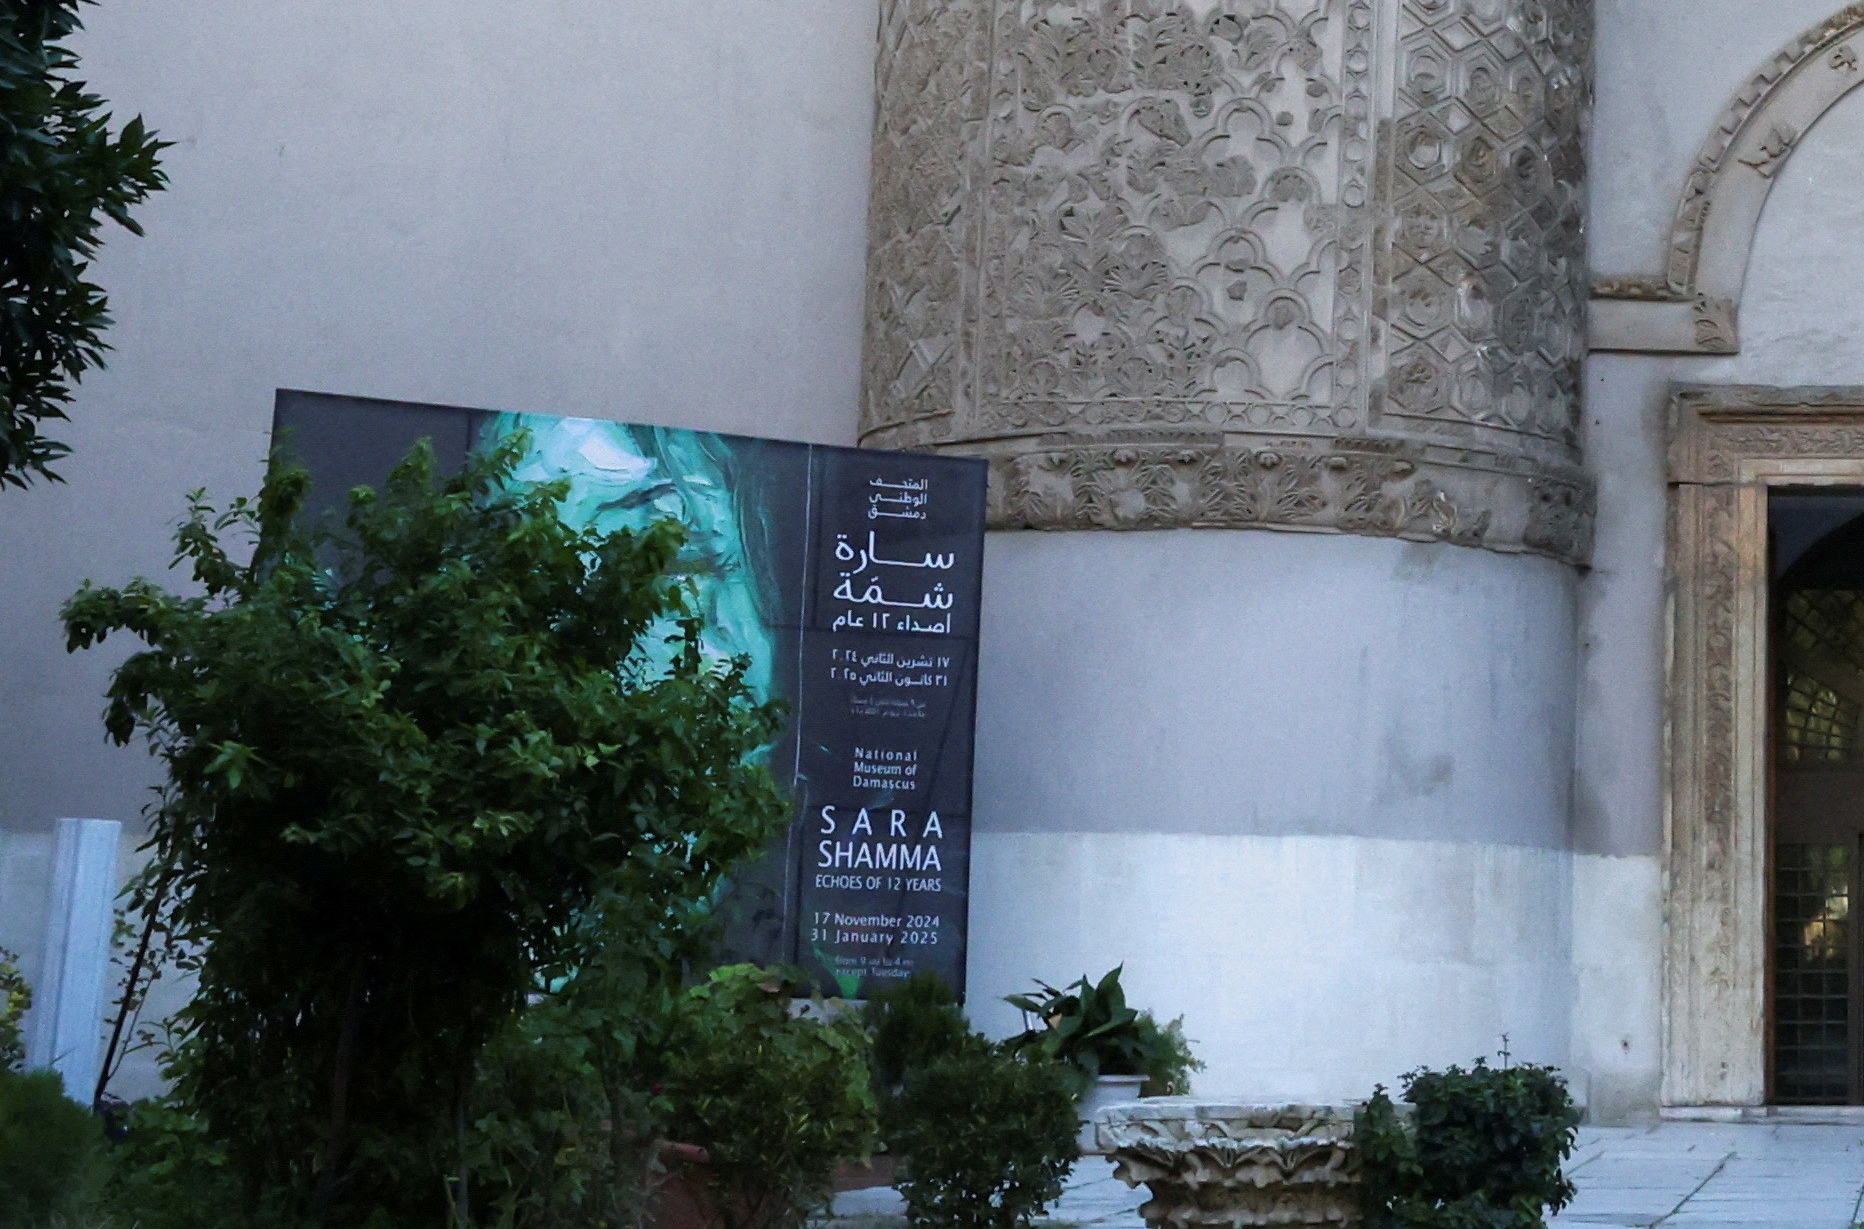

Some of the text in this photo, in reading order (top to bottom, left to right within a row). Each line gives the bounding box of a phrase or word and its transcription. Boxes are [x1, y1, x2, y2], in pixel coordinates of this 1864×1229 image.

[869, 477, 928, 490] المتحف
[868, 492, 928, 507] الوطني
[867, 504, 927, 519] دمشق
[835, 530, 955, 574] سارة
[832, 610, 864, 632] عام
[872, 612, 890, 629] ١٢
[896, 654, 933, 669] تشرين
[937, 656, 950, 668] ١٧
[935, 674, 948, 686] ٣١
[854, 746, 917, 761] National
[853, 761, 917, 776] Museum of
[852, 775, 916, 790] Damascus
[817, 839, 942, 872] SHAMMA
[815, 874, 942, 892] ECHOES OF 12 YEARS
[814, 912, 940, 928] 17 November 2024
[811, 928, 938, 945] 31 January 2025
